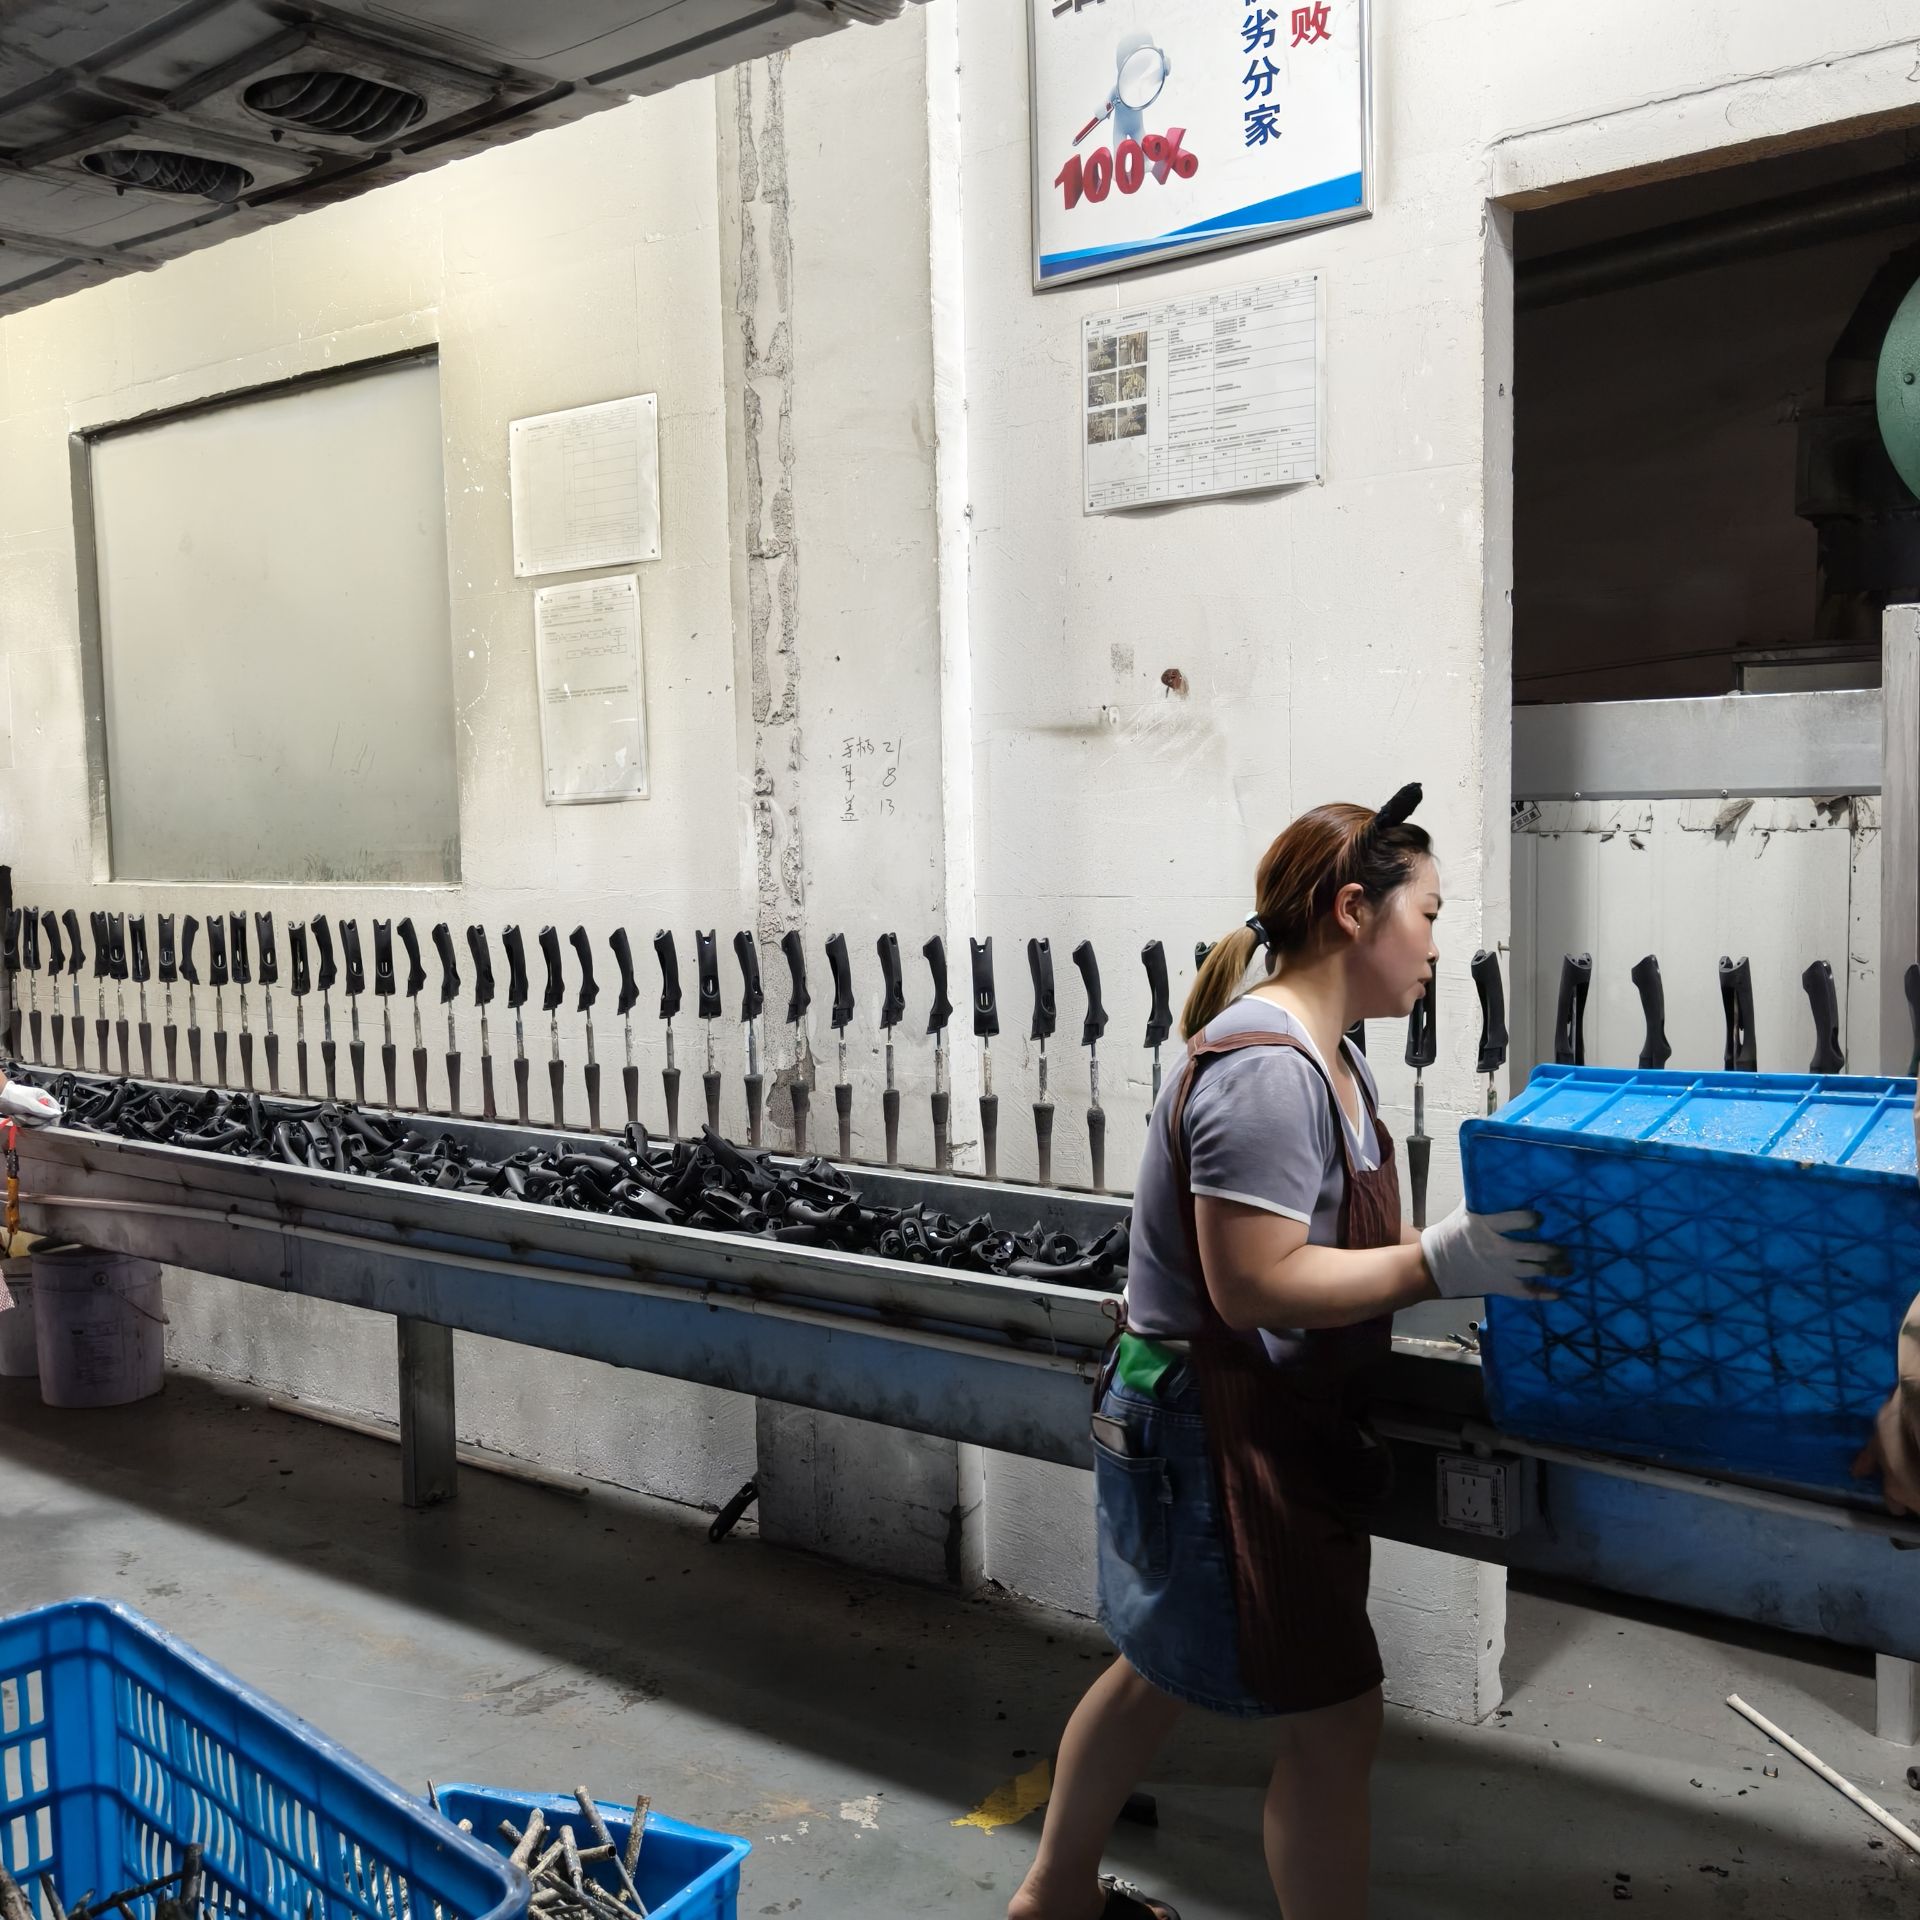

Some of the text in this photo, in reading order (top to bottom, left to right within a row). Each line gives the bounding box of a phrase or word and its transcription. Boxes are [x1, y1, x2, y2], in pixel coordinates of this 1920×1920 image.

[1290, 1, 1332, 48] 败
[1240, 0, 1282, 147] 劣分家
[1055, 127, 1199, 210] 100%
[882, 737, 902, 767] 21
[882, 767, 897, 787] 8
[880, 798, 896, 816] 13
